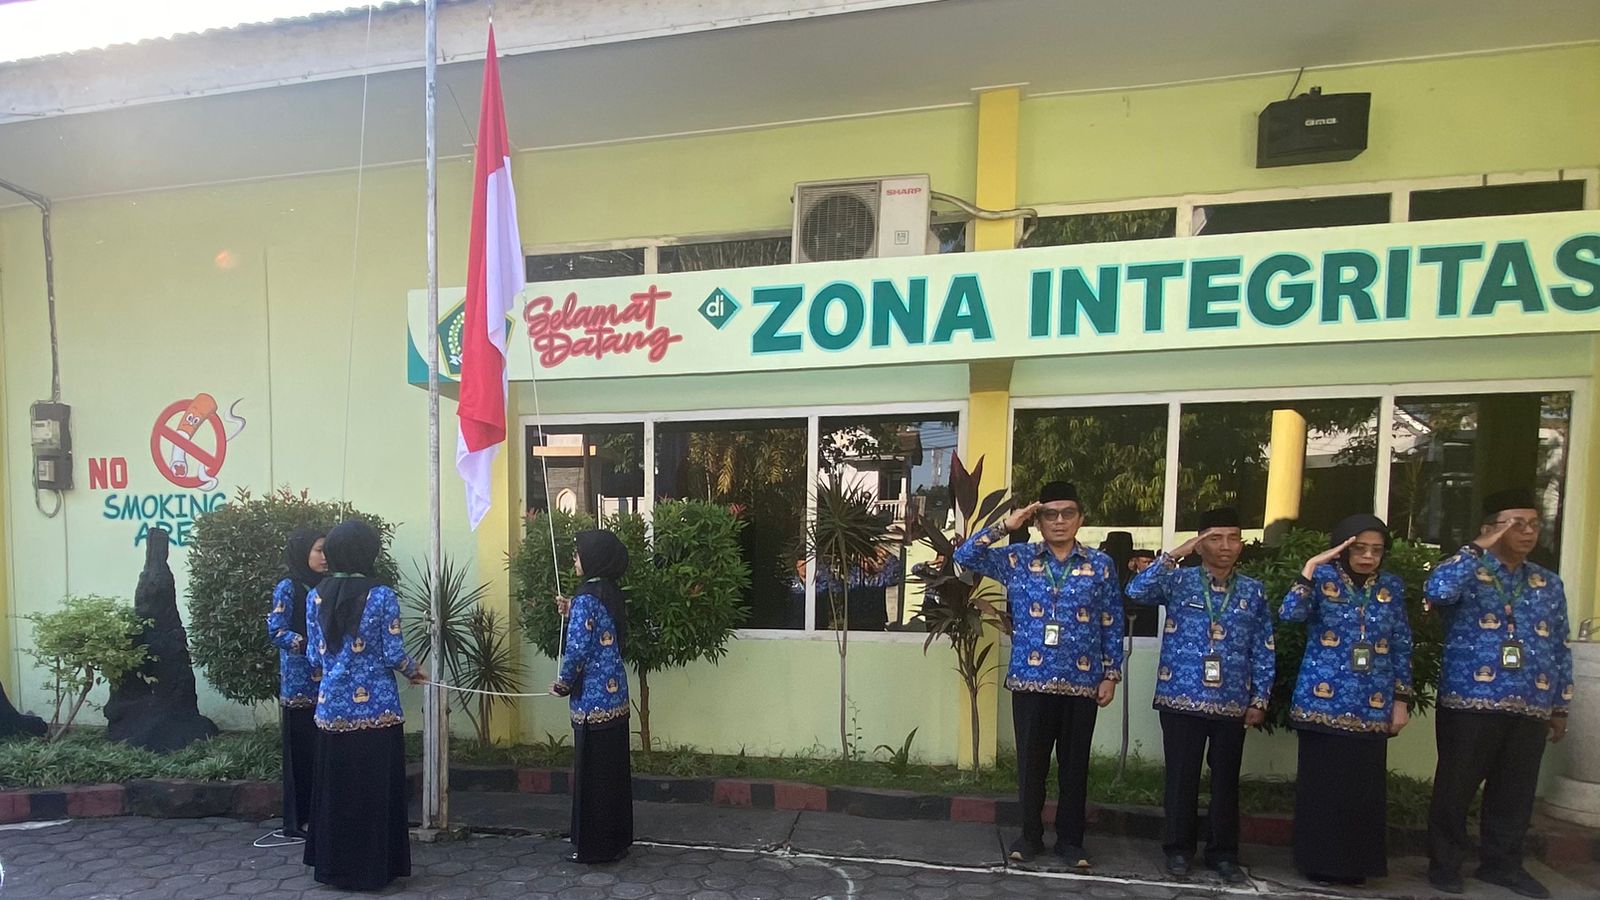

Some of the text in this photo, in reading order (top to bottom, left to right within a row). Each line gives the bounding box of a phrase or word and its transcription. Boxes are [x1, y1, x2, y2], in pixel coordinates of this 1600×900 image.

[886, 187, 922, 196] SHARP
[524, 284, 672, 338] Selamat
[705, 232, 1600, 355] di ZONA INTEGRITAS
[533, 326, 683, 368] Datang
[88, 457, 128, 489] NO
[134, 520, 198, 548] ARE
